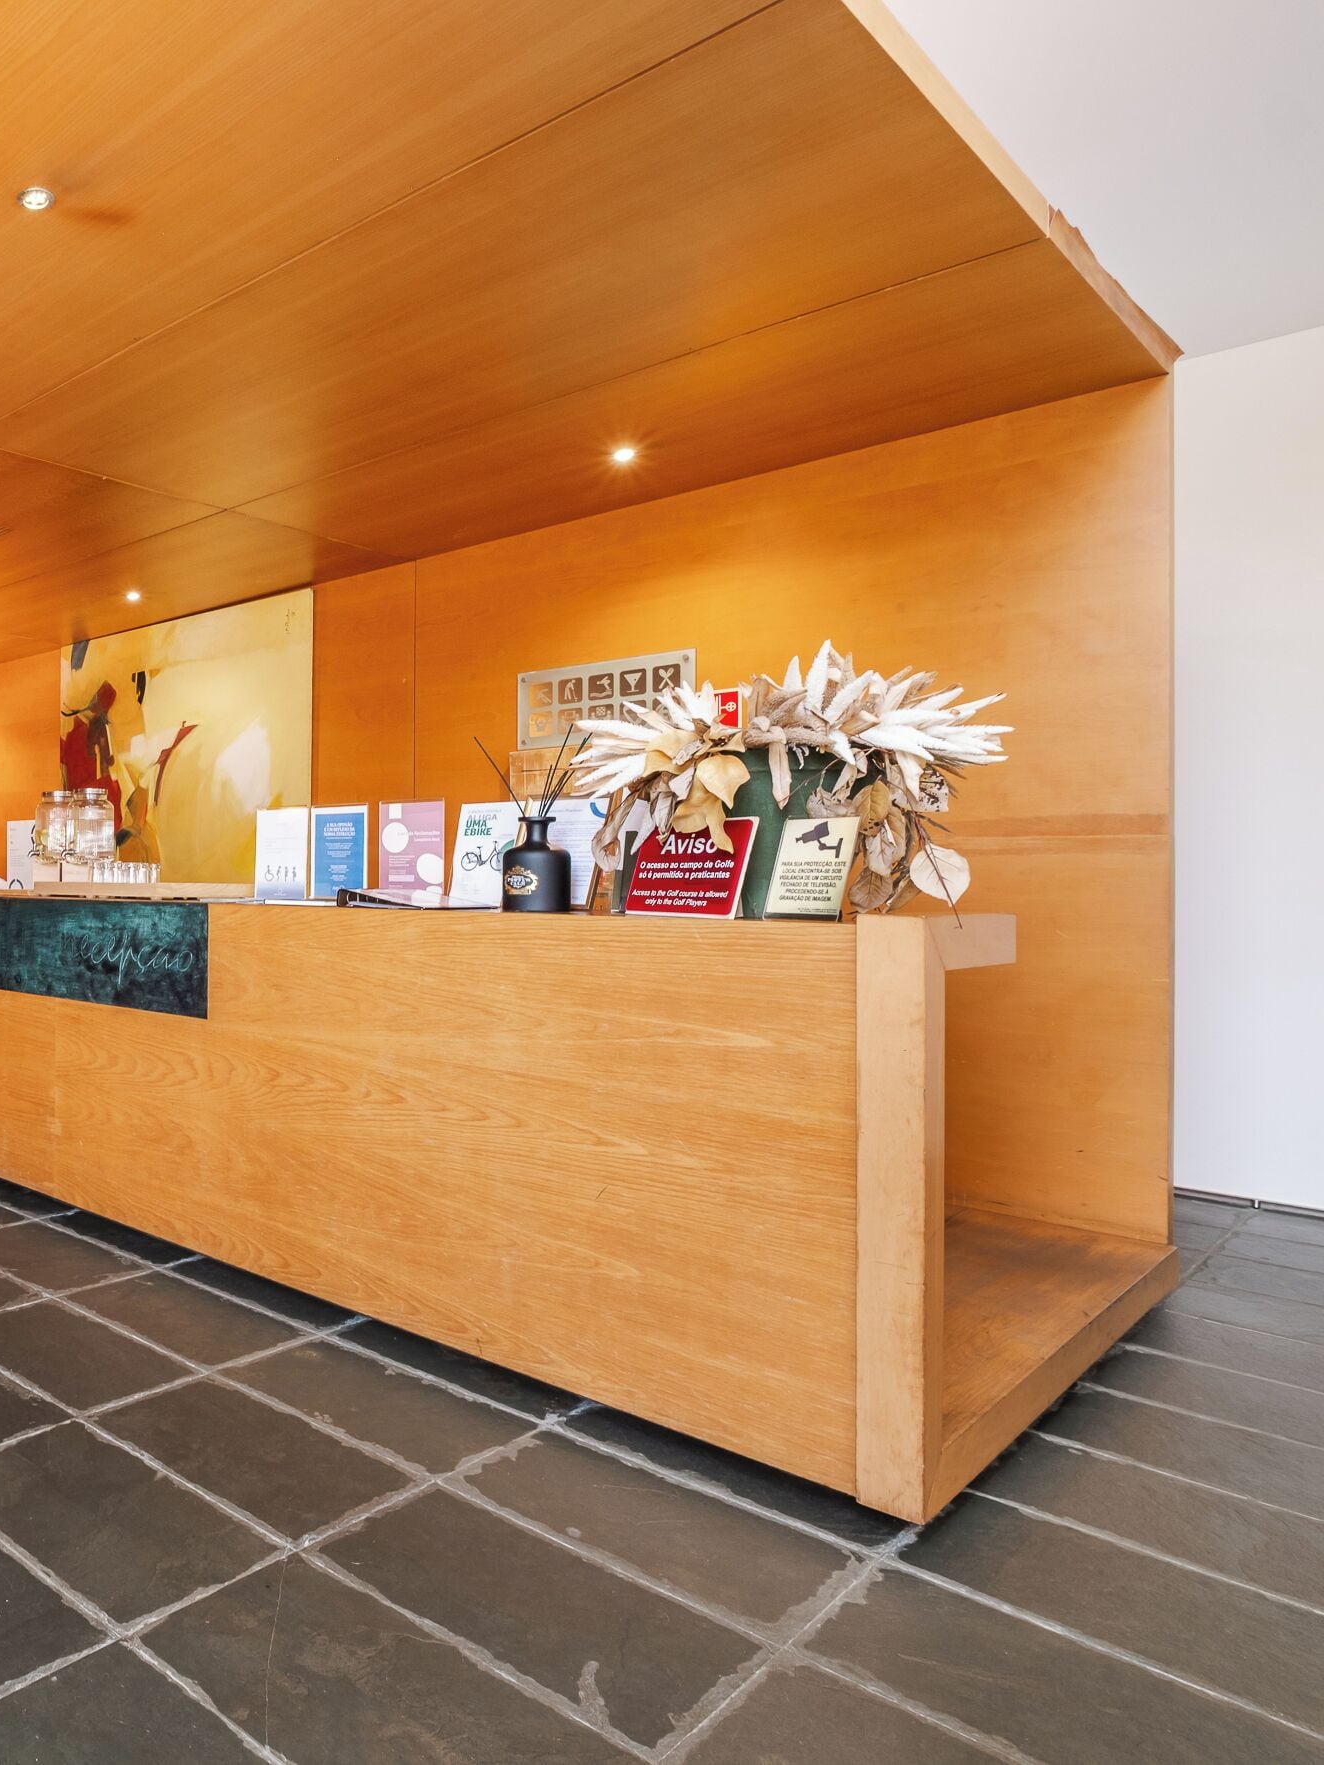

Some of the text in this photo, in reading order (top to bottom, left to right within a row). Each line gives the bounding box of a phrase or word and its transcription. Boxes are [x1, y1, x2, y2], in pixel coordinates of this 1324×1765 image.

[466, 820, 487, 828] UMA
[464, 827, 493, 836] EBIKE
[680, 862, 702, 870] campo
[704, 860, 713, 868] de
[715, 860, 734, 868] Golfe
[653, 871, 683, 879] permitido
[690, 871, 730, 880] praticantes
[645, 898, 656, 906] only
[686, 899, 707, 907] Players
